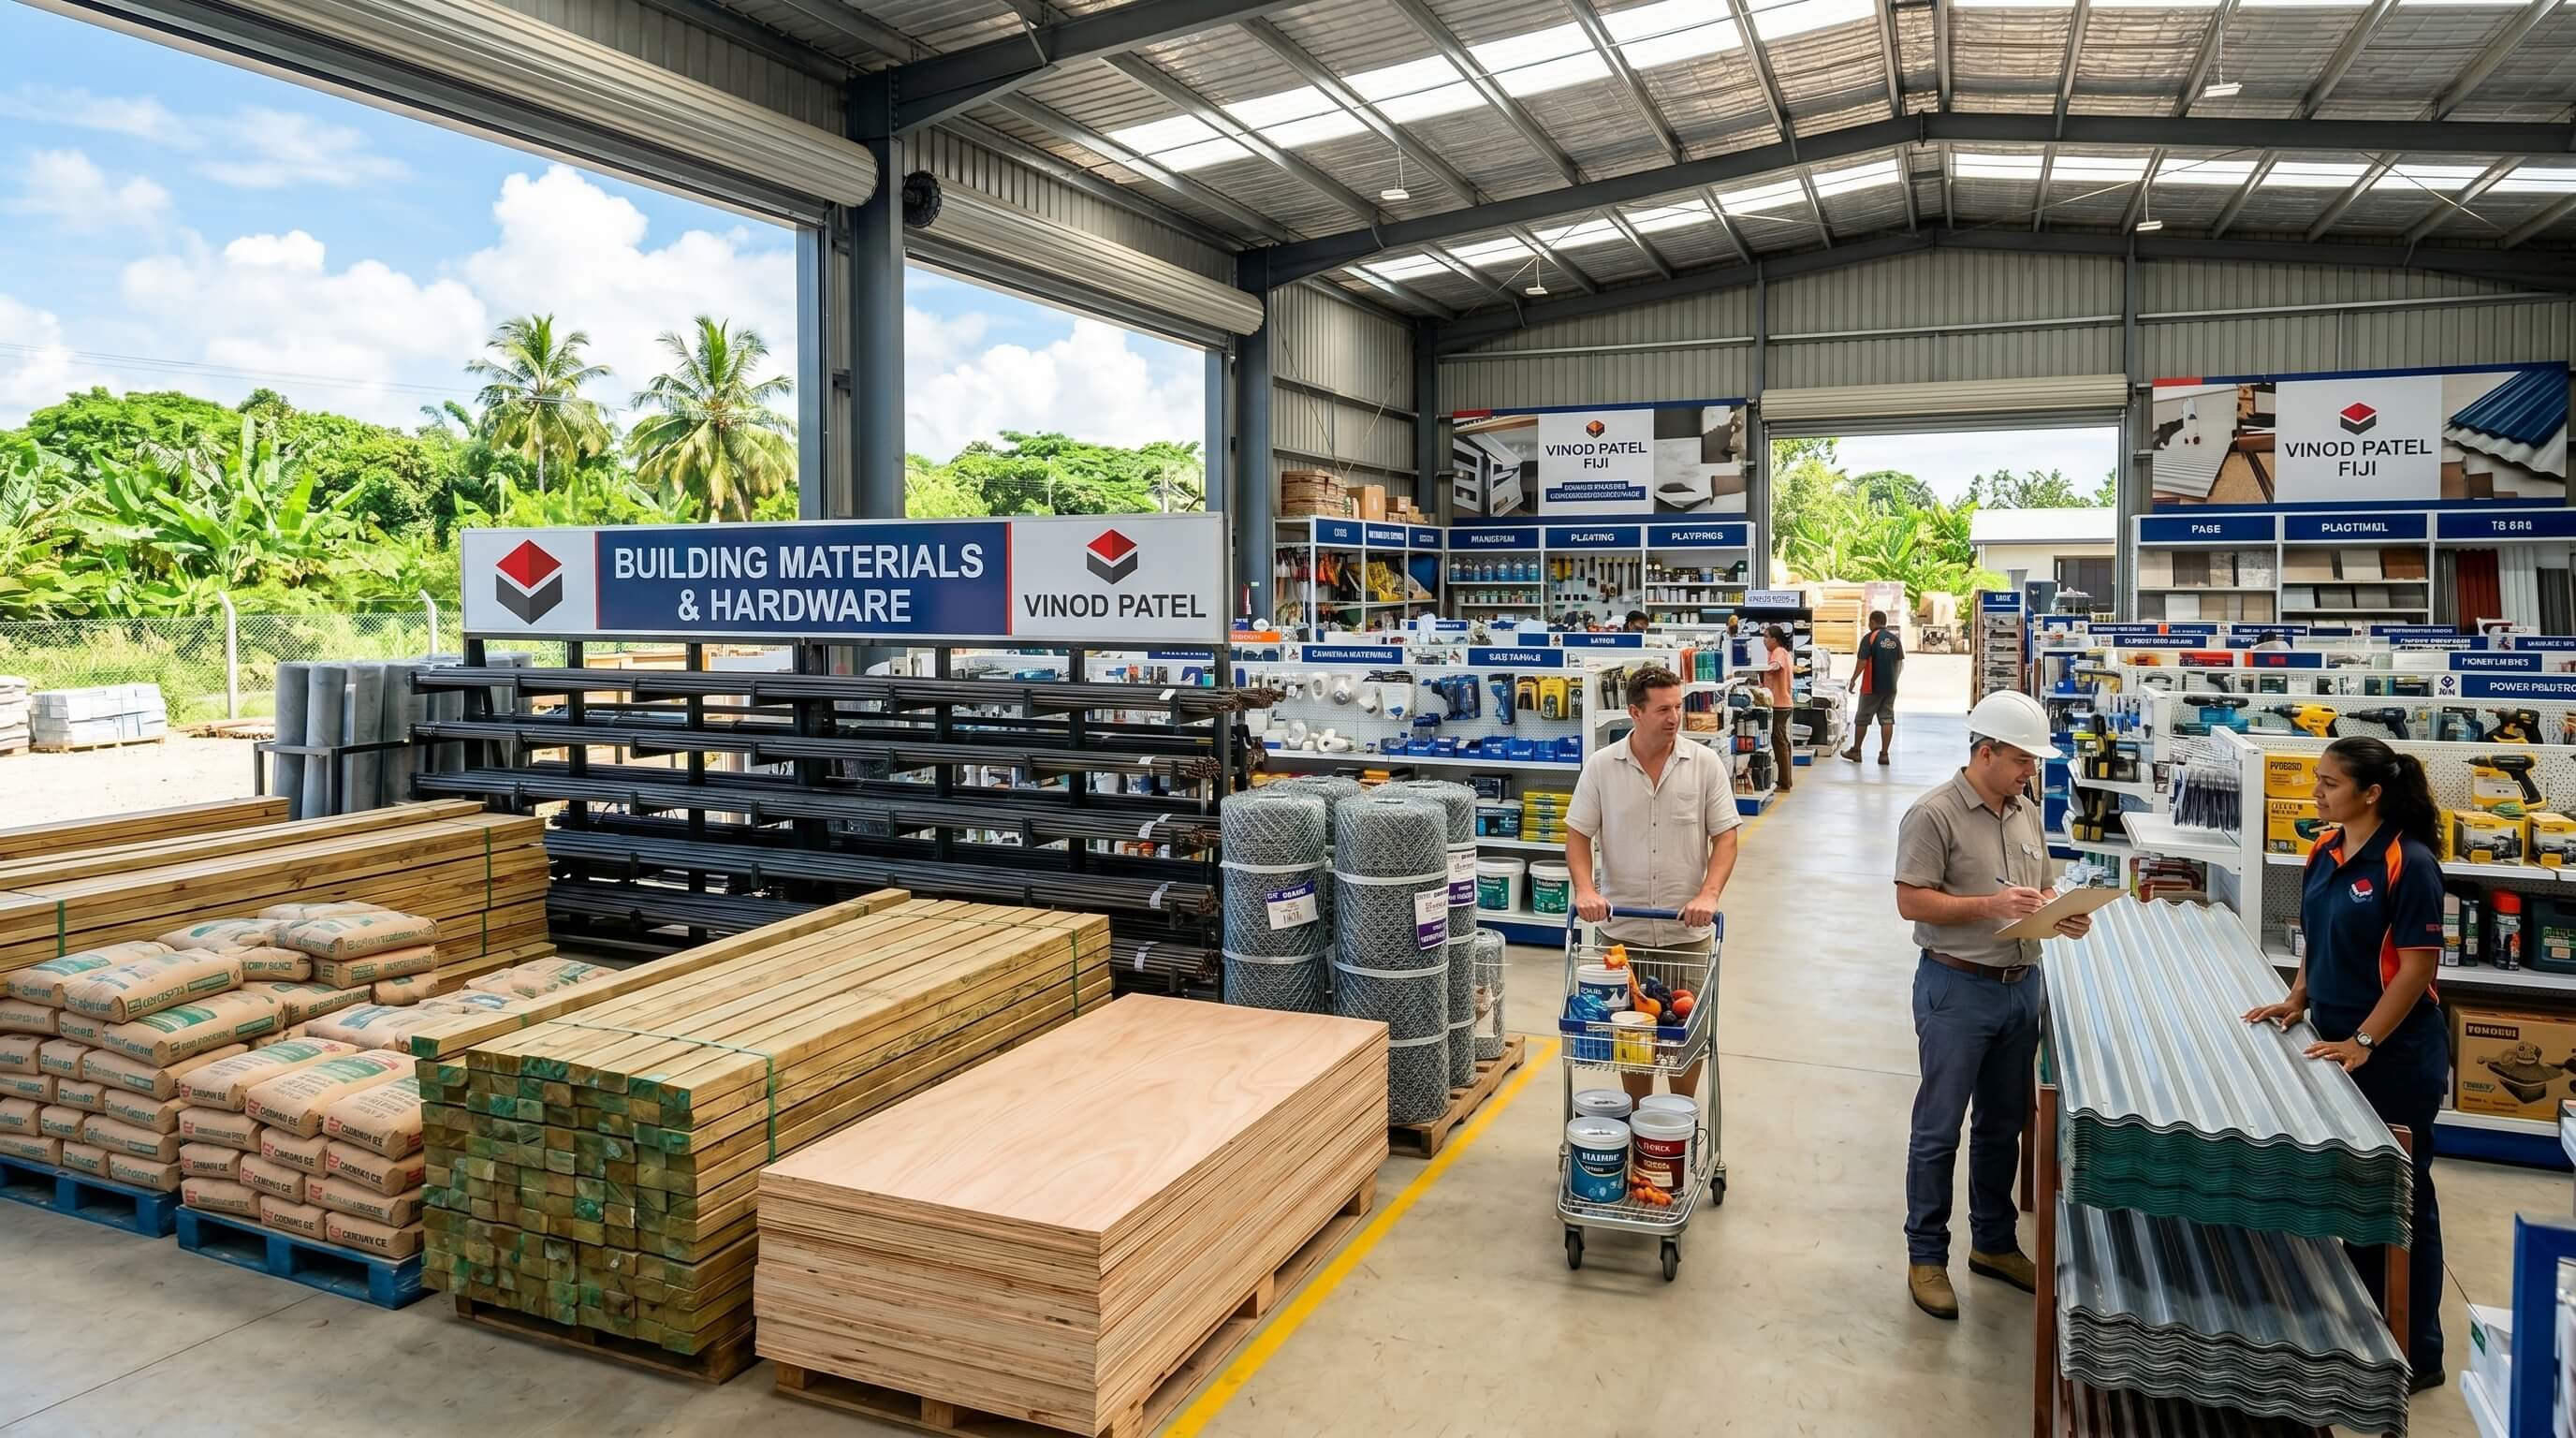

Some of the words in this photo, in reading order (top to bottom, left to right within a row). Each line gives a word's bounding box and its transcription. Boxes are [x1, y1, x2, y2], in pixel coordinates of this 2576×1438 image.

[1545, 443, 1595, 457] VINOD
[1599, 441, 1648, 456] PATEL
[2285, 441, 2355, 458] VINOD
[2362, 438, 2433, 456] PATEL
[1583, 458, 1609, 469] FIJI
[2338, 461, 2377, 477] FIJI
[614, 546, 768, 580] BUILDING
[779, 541, 984, 580] MATERIALS
[677, 588, 701, 623] &
[711, 588, 912, 623] HARDWARE
[1023, 594, 1110, 619] VINOD
[1118, 593, 1207, 619] PATEL
[2490, 682, 2529, 691] POWER
